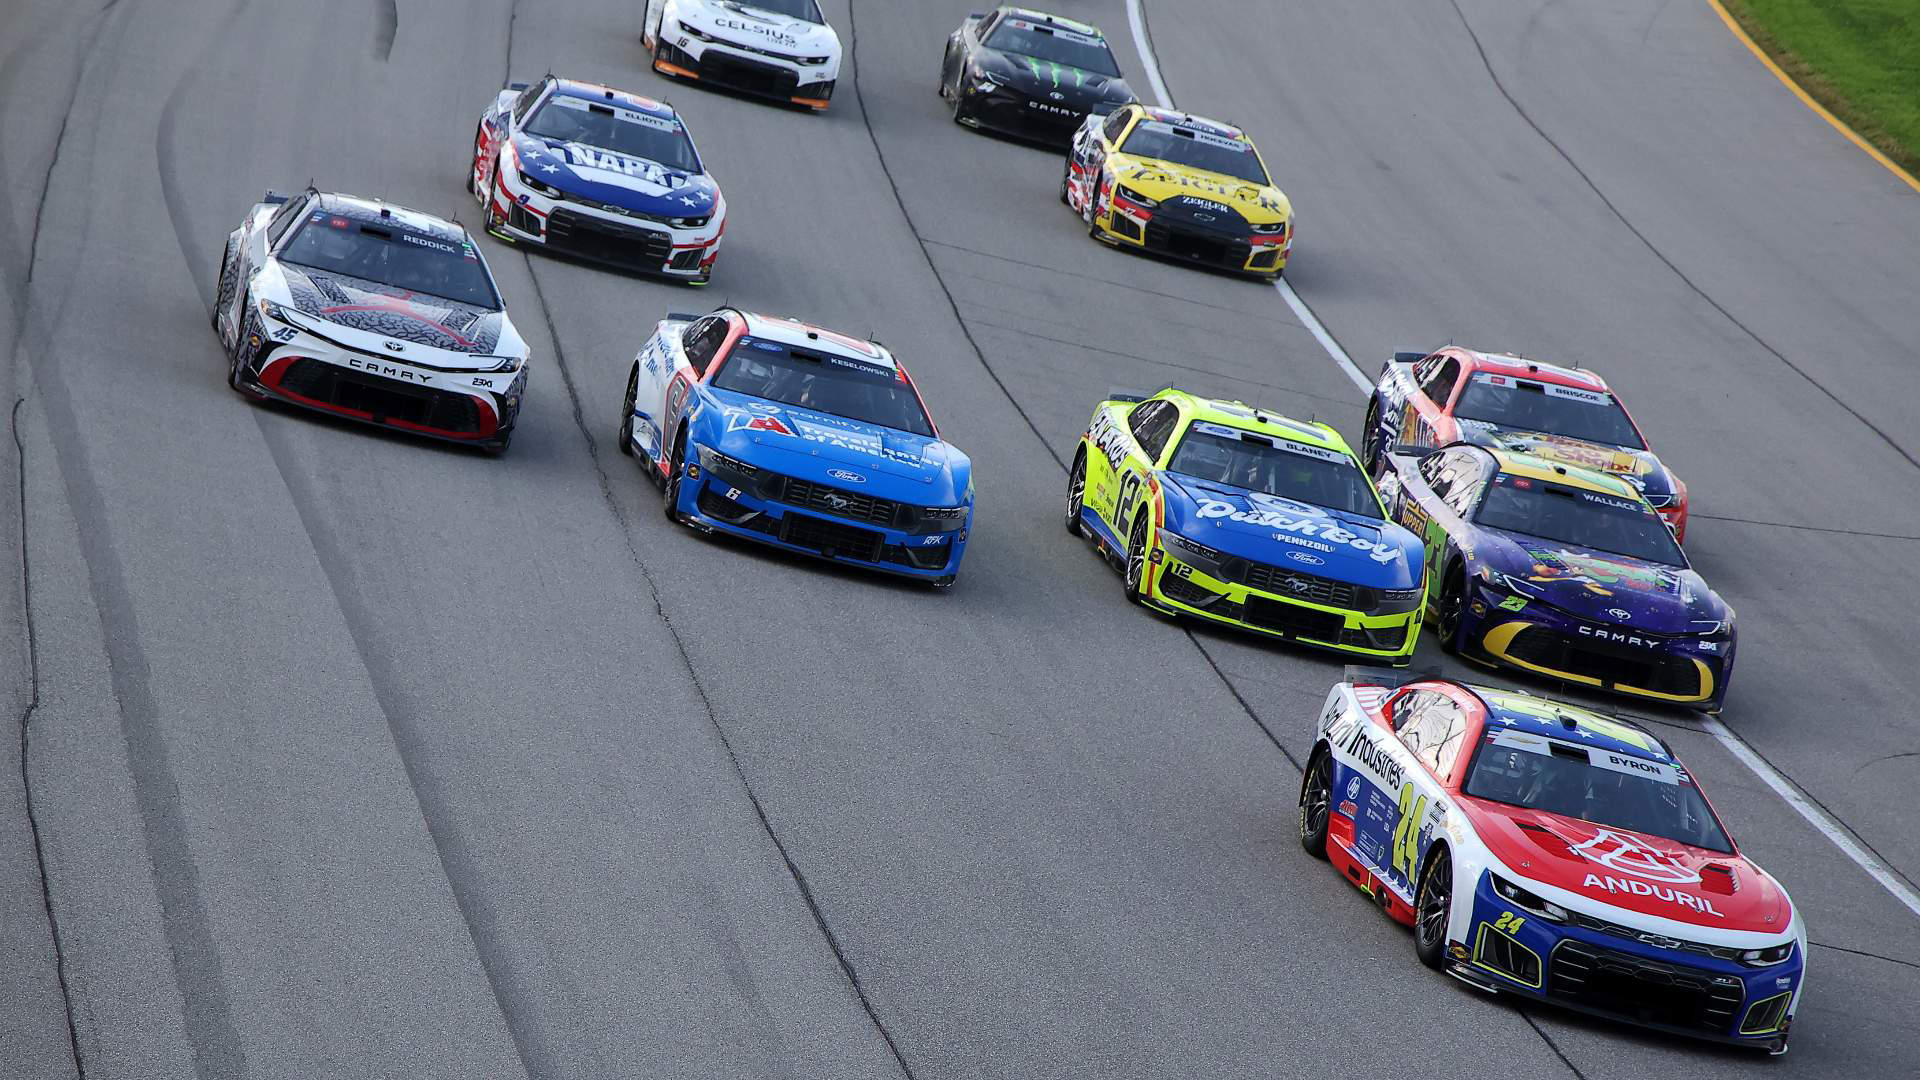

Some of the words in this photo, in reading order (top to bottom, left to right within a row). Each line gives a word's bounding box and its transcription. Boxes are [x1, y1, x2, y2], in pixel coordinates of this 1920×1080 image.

[715, 18, 796, 44] CELSIUS
[676, 36, 688, 48] 16
[1029, 101, 1080, 117] CAMRY
[624, 112, 665, 127] ELLIOTT
[571, 144, 673, 188] NAPA
[1182, 196, 1229, 213] ZEIGLER
[403, 234, 456, 254] REDDICK
[272, 326, 300, 342] 45
[349, 358, 433, 383] CAMRY
[830, 357, 890, 378] KESELOWSKI
[1555, 387, 1601, 402] BRISCOE
[1286, 442, 1332, 458] BLANEY
[725, 486, 742, 501] 6
[1112, 467, 1142, 538] 12
[1583, 492, 1638, 512] WALLACE
[1196, 498, 1316, 536] Dutch
[1319, 523, 1400, 563] Boy
[1404, 512, 1425, 533] UPPER
[1277, 533, 1332, 553] PENNZOIL
[1174, 562, 1194, 579] 12
[1579, 625, 1661, 649] CAMRY
[1609, 755, 1662, 775] BYRON
[1392, 782, 1428, 884] 24
[1583, 873, 1725, 918] ANDURIL
[1494, 911, 1526, 935] 24
